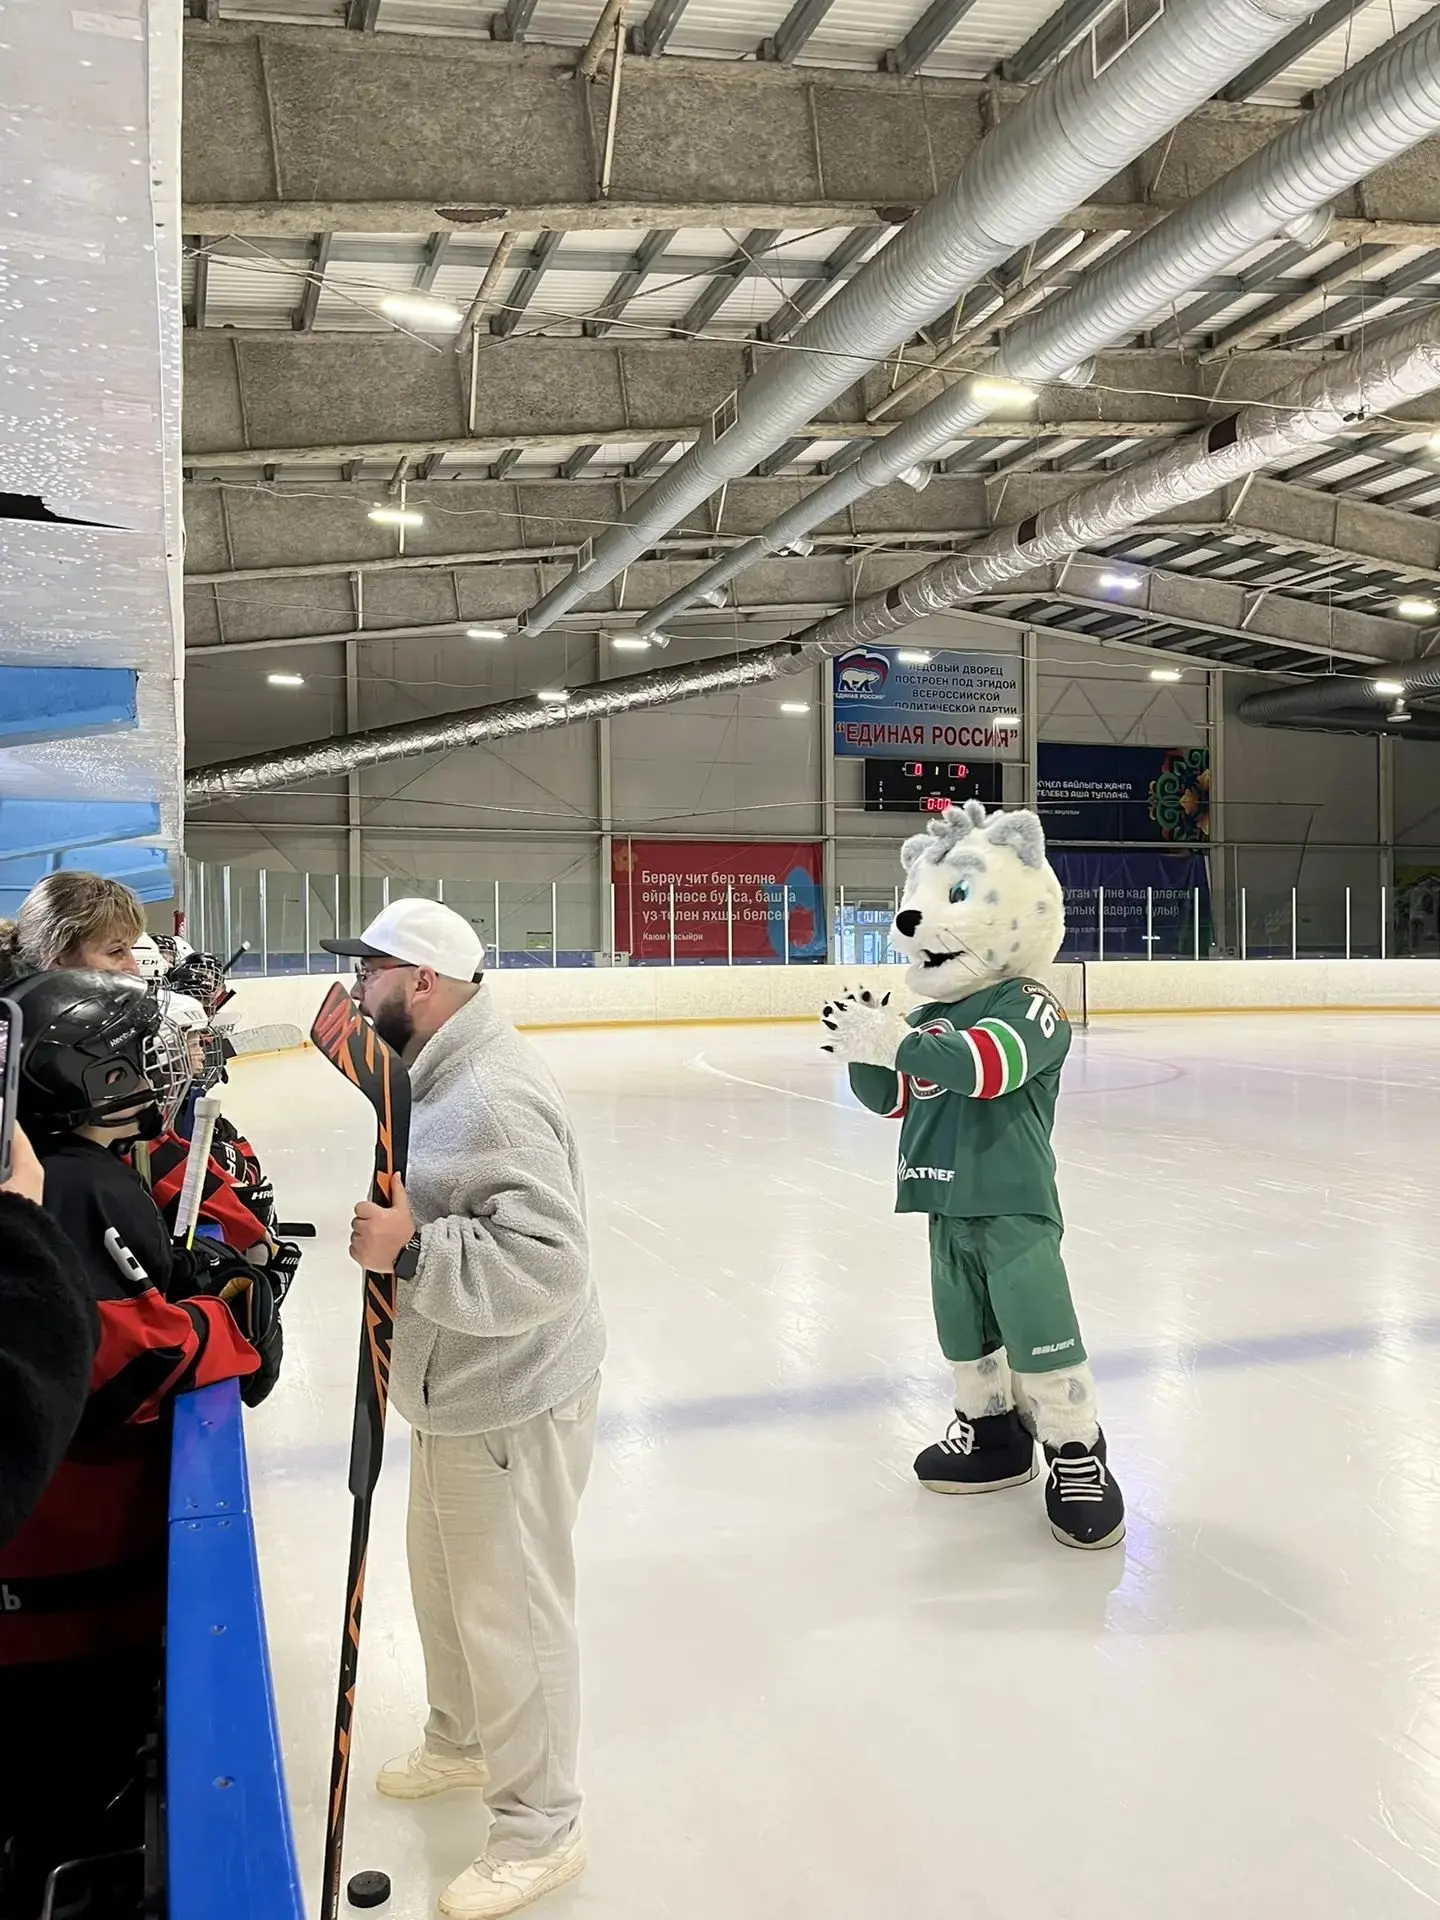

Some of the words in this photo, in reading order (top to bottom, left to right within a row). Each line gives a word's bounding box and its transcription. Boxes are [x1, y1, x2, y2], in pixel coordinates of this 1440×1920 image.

[962, 665, 1003, 676] ДВОРЕЦ
[895, 675, 949, 686] ПОСТРОЕН
[952, 677, 973, 688] ПОД
[976, 679, 1017, 690] ЭГИДОЙ
[894, 702, 976, 713] ПОЛИТИЧЕСКОЙ
[979, 705, 1017, 715] ПАРТИИ
[686, 872, 708, 885] чит
[711, 871, 736, 887] бер
[738, 873, 776, 884] телне
[755, 889, 796, 903] баша
[1064, 888, 1090, 901] уган
[1092, 888, 1125, 899] тлне
[1099, 905, 1143, 918] адерле
[642, 932, 666, 941] Каюм
[1024, 993, 1060, 1039] 16
